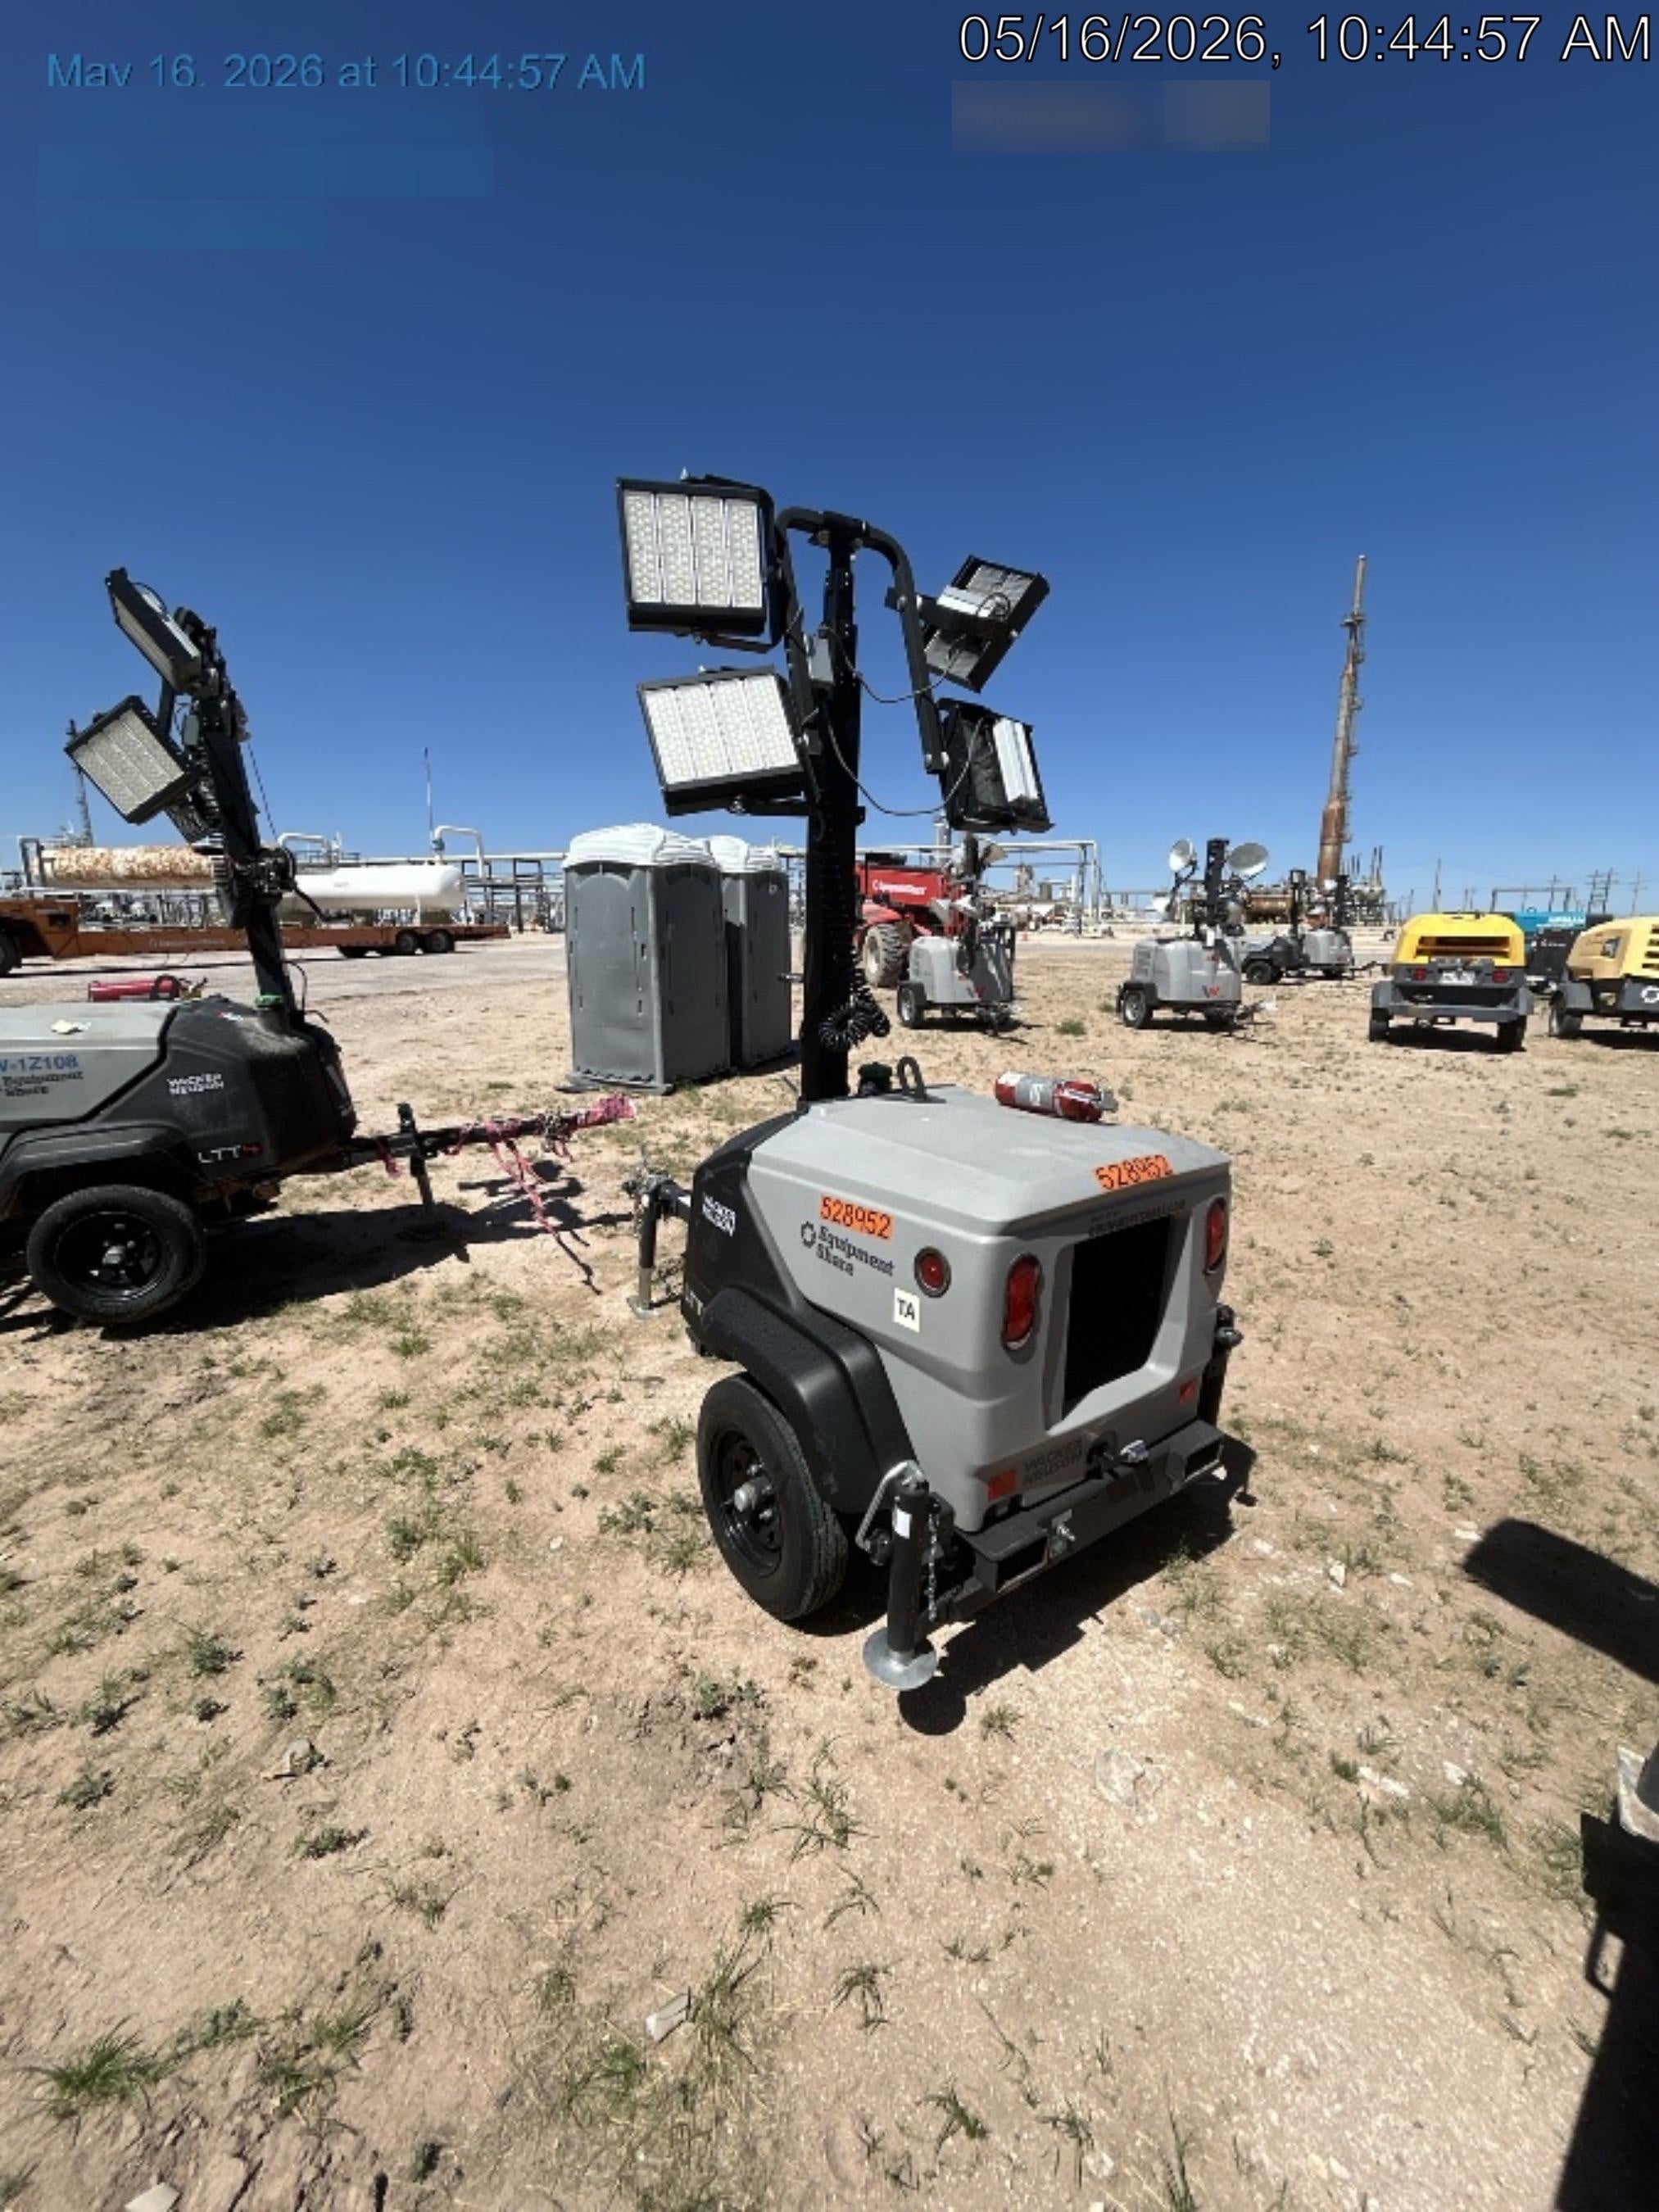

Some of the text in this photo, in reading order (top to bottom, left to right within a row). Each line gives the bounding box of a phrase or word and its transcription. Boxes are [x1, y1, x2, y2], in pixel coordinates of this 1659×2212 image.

[1095, 1154, 1173, 1190] 528952
[820, 1195, 892, 1240] 528952
[816, 1243, 854, 1276] Share
[818, 1225, 895, 1276] Equipment
[896, 1296, 916, 1321] TA
